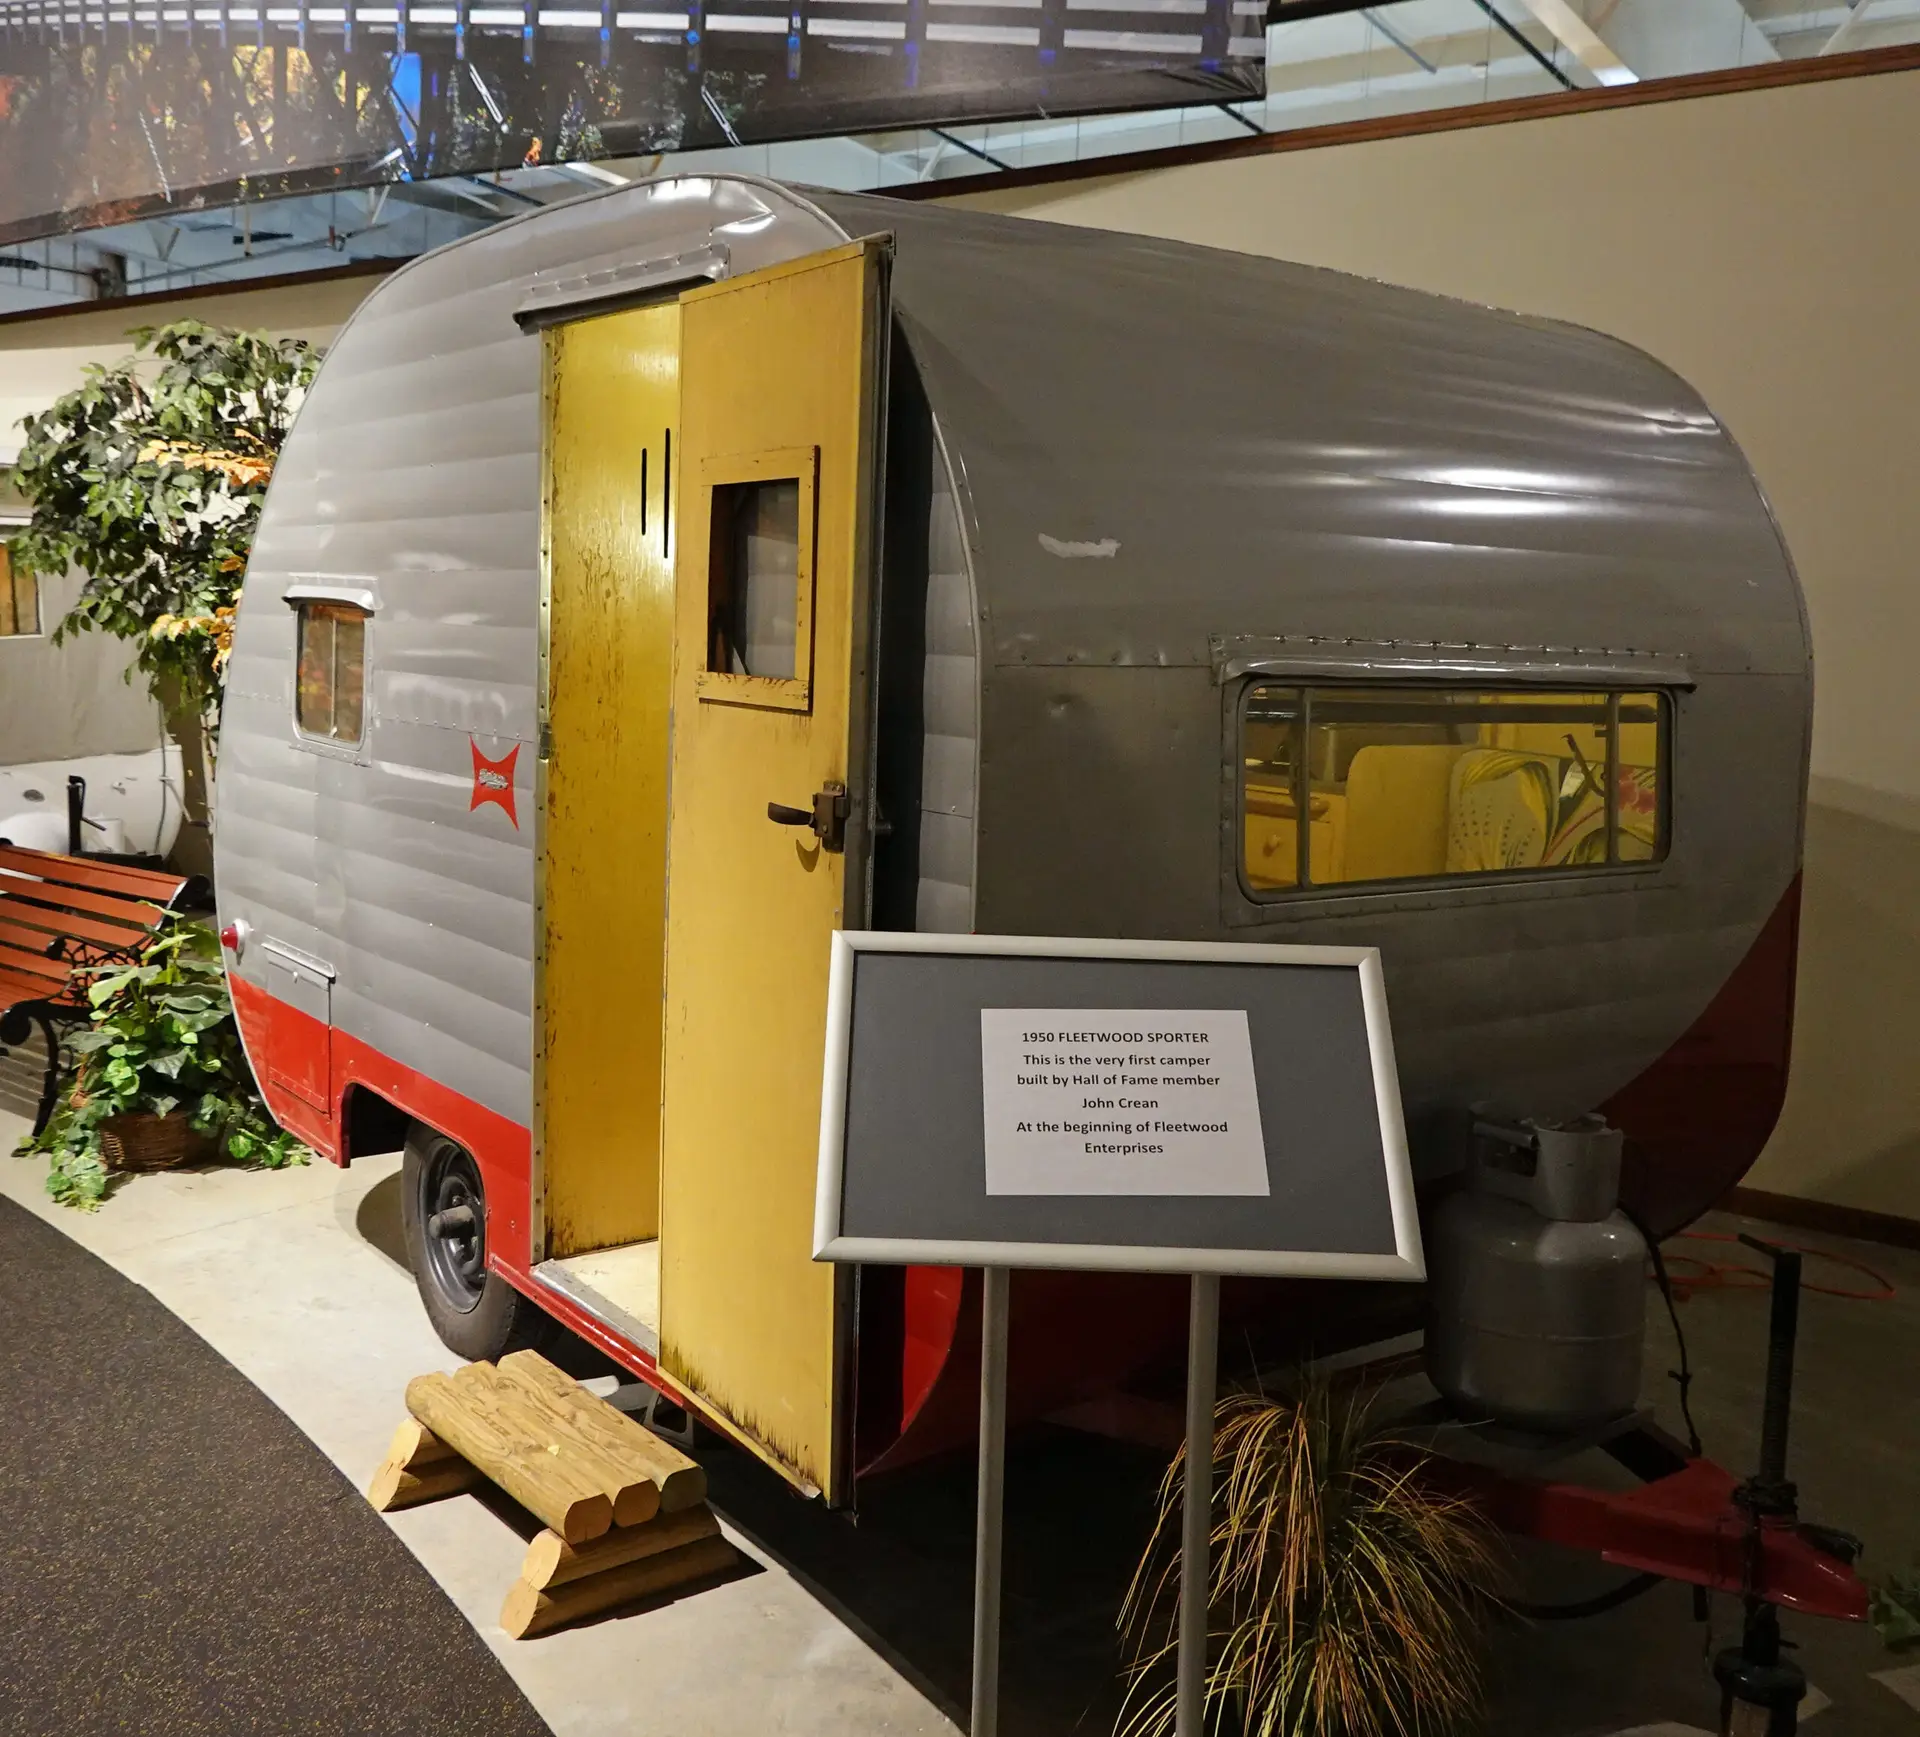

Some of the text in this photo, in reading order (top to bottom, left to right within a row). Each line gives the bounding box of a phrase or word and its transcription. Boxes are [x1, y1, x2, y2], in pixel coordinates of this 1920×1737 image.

[1023, 1032, 1209, 1043] 1950 FLEETWOOD SPORTER
[1023, 1055, 1210, 1067] This is the very first camper
[1018, 1074, 1220, 1087] built by Hall of Fame member
[1082, 1098, 1158, 1108] John Crean
[1017, 1121, 1228, 1134] At the beginning of Fleetwood
[1085, 1142, 1163, 1155] Enterprises
